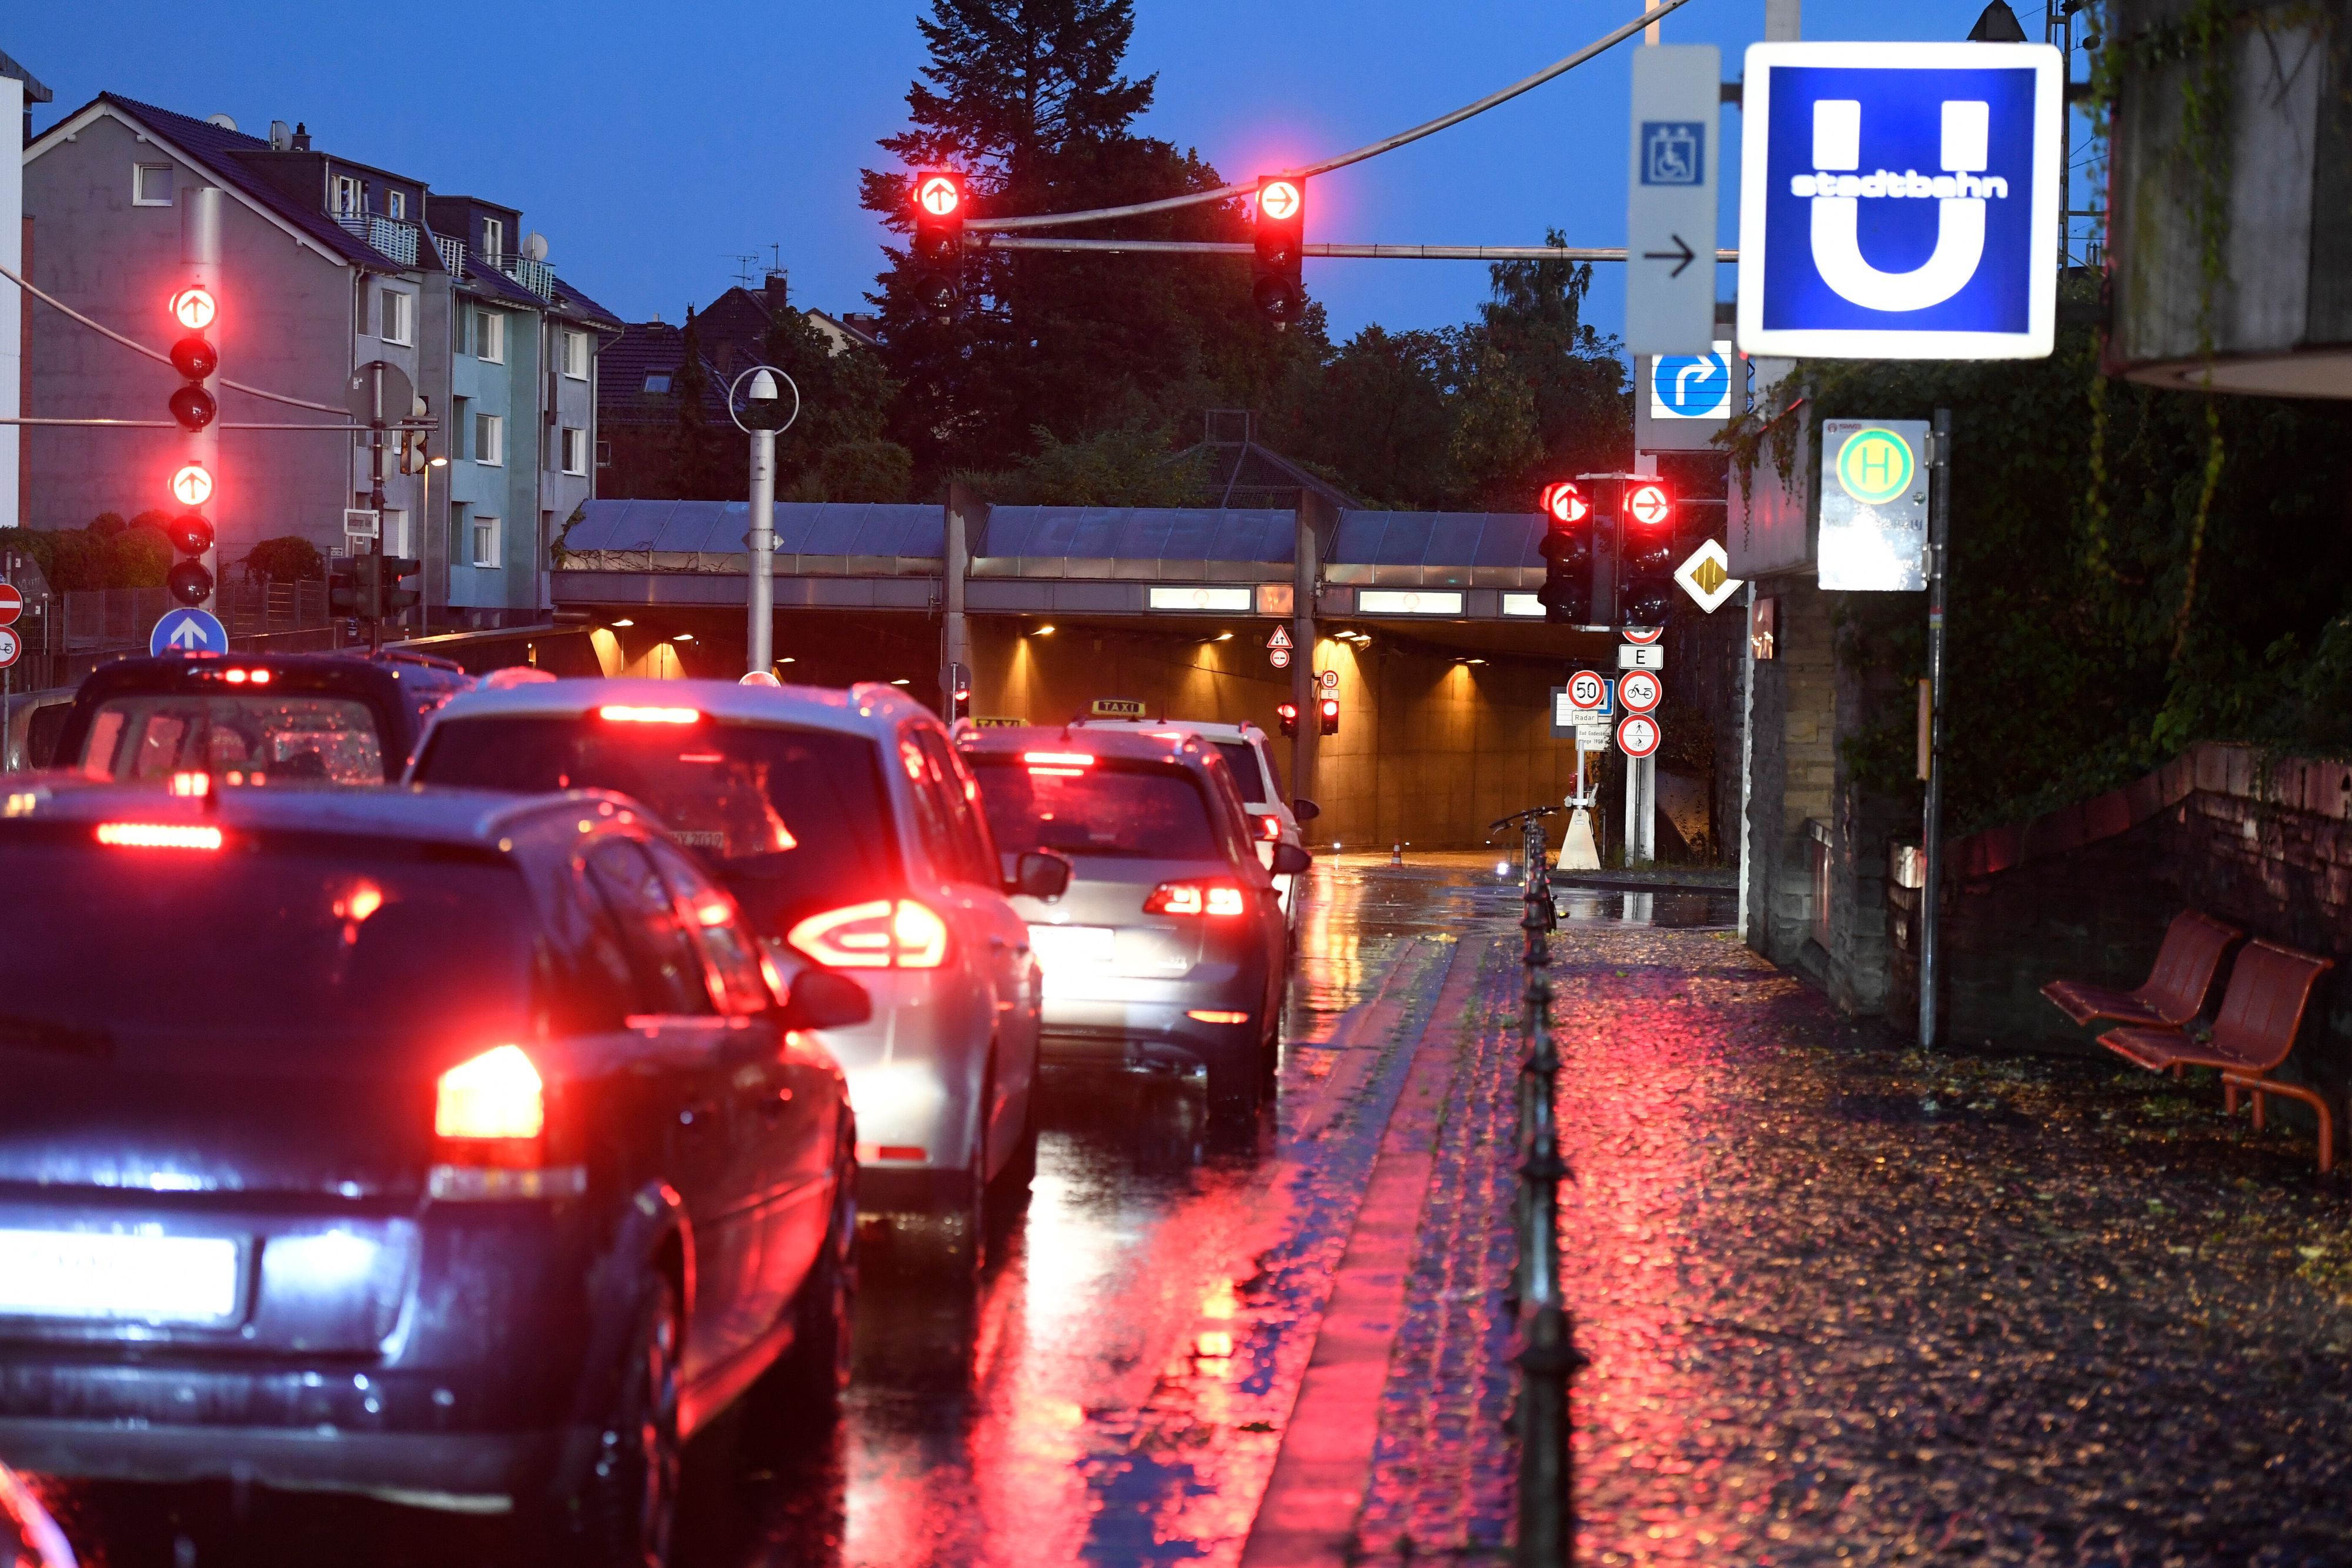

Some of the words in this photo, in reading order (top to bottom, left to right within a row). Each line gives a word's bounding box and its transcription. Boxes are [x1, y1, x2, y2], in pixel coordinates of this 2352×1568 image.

[1790, 169, 2008, 199] stadtbahn
[1862, 447, 1889, 484] H
[1636, 650, 1646, 664] E
[1576, 682, 1596, 698] 50
[1104, 702, 1134, 712] TAXI
